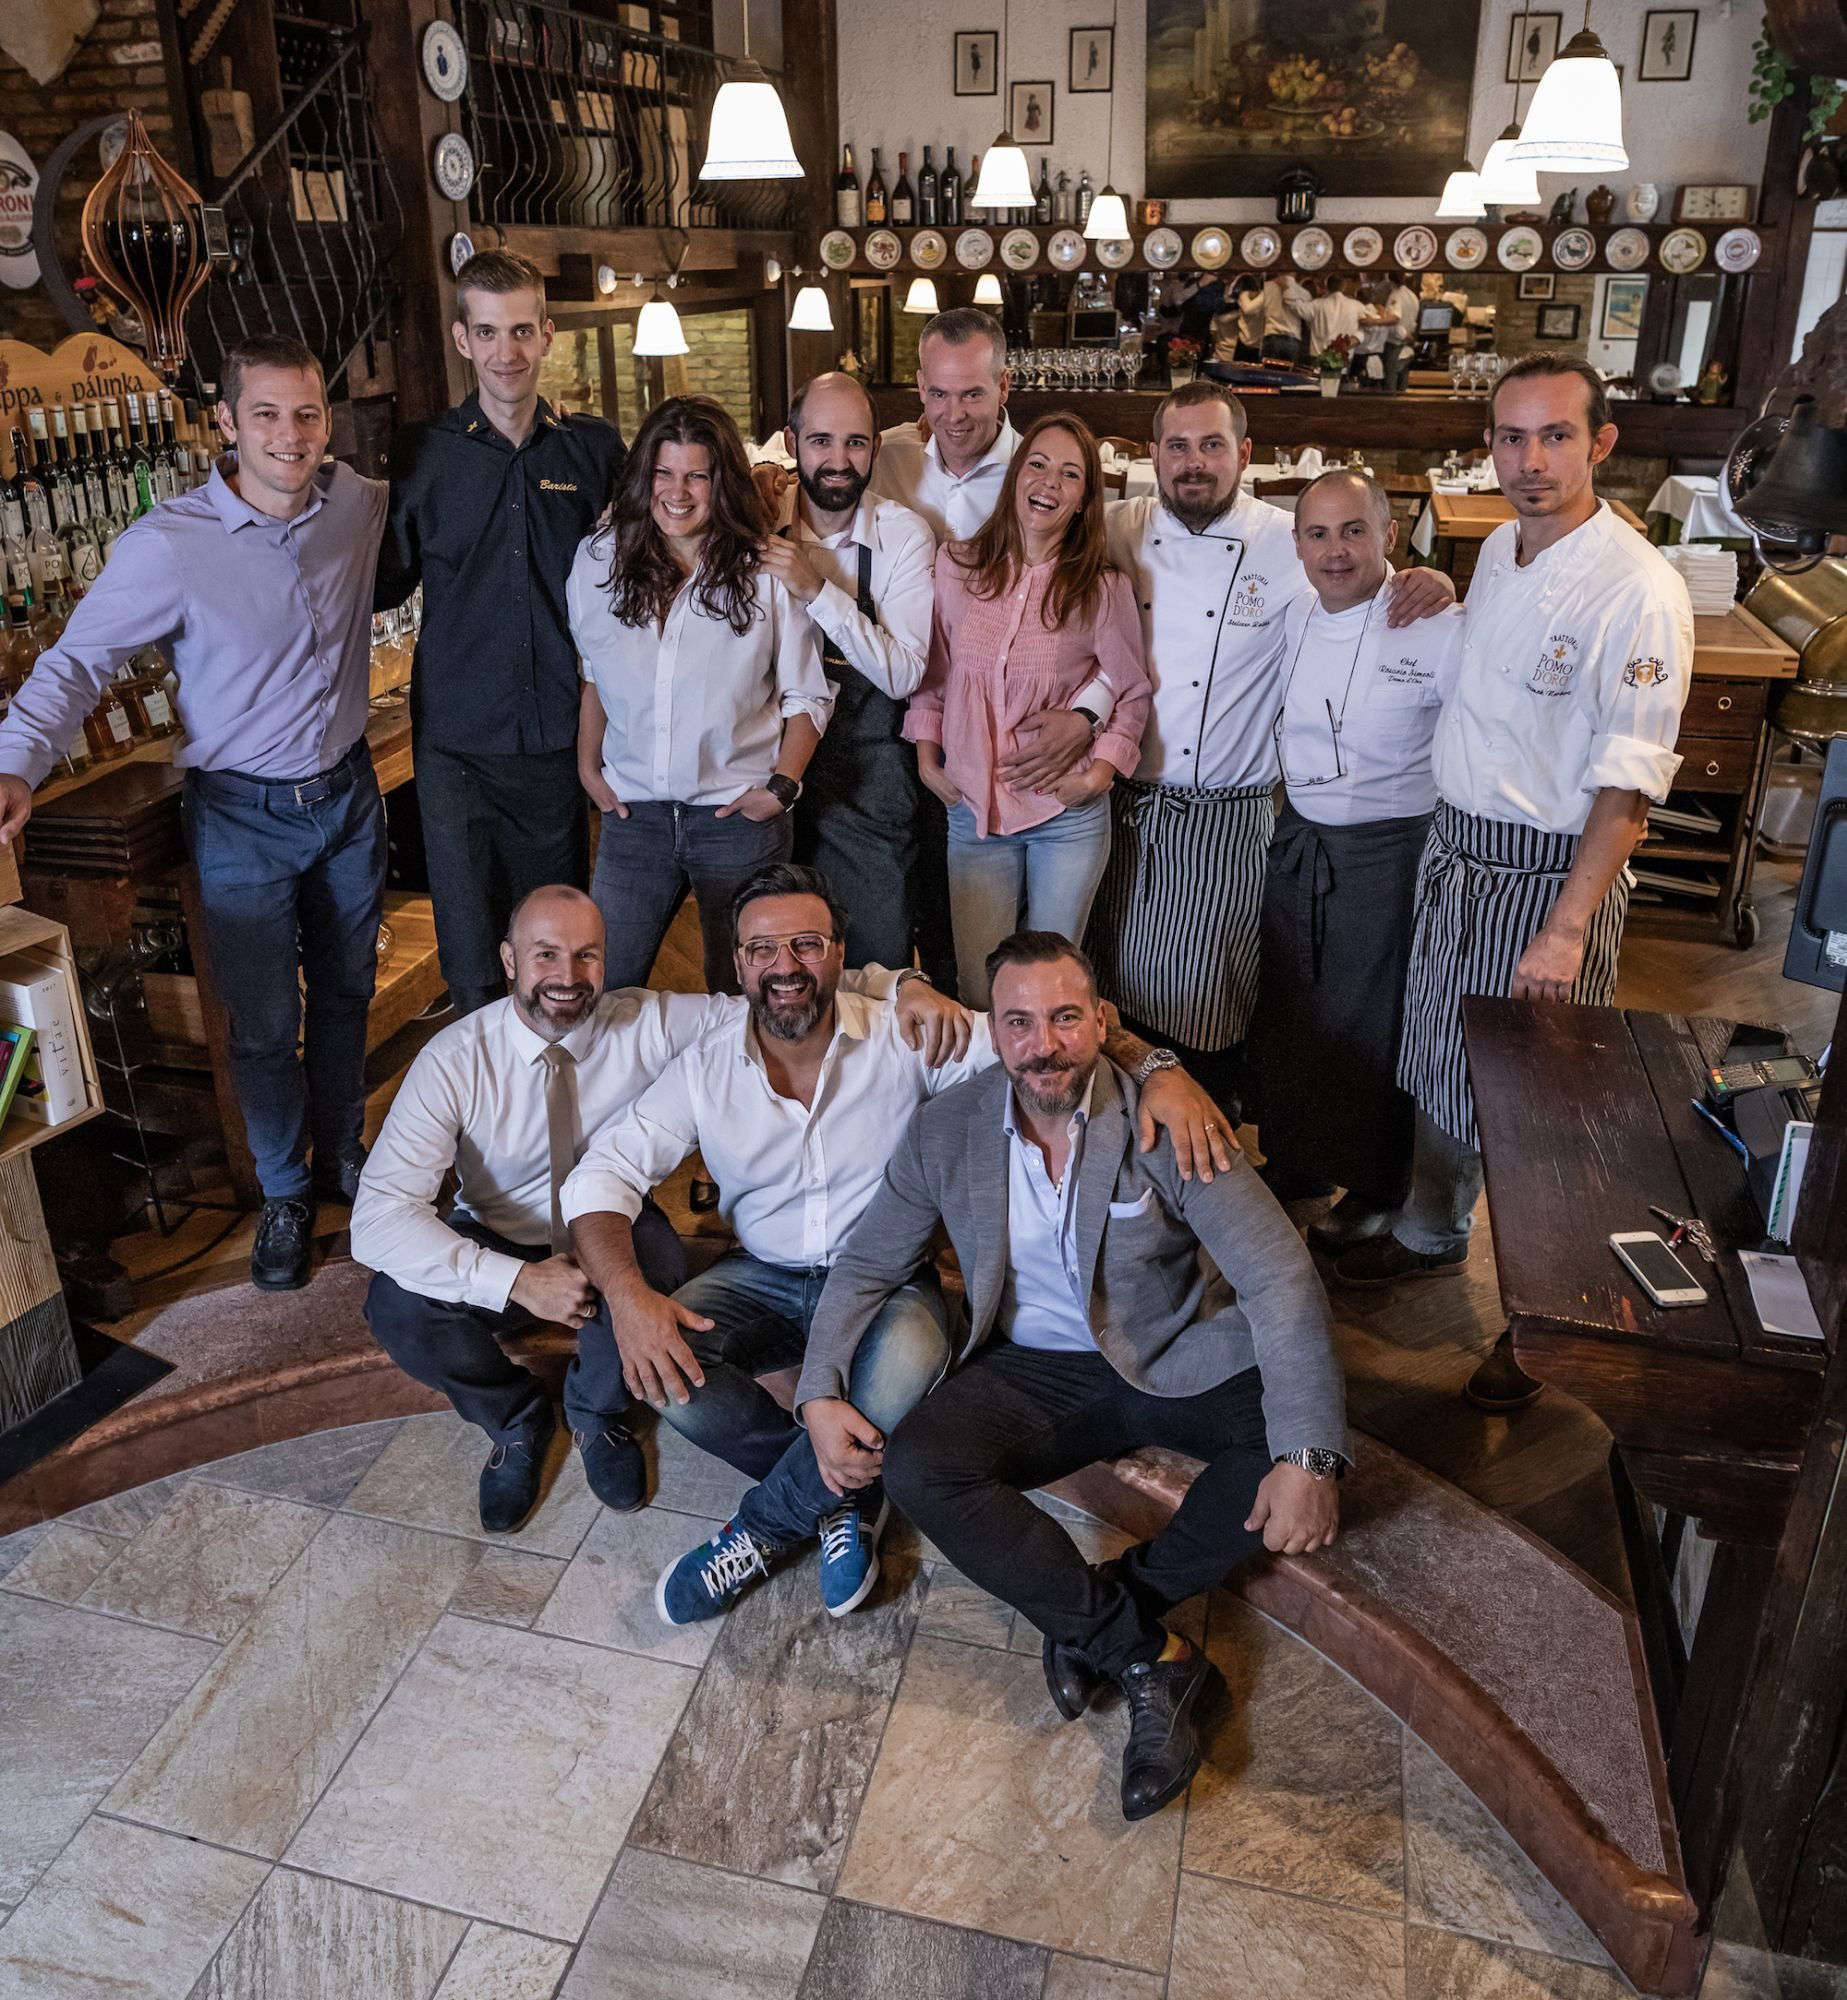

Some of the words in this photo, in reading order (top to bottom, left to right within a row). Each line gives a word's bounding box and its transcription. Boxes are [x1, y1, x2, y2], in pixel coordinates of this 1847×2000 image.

[71, 372, 145, 401] pálinka
[540, 479, 578, 491] Barista
[1240, 573, 1269, 586] TRATTORIA
[1235, 591, 1265, 608] POMO
[1233, 604, 1264, 618] D'ORO
[1400, 657, 1418, 667] Chef
[1537, 653, 1573, 676] POMO
[1532, 668, 1570, 687] D'ORO
